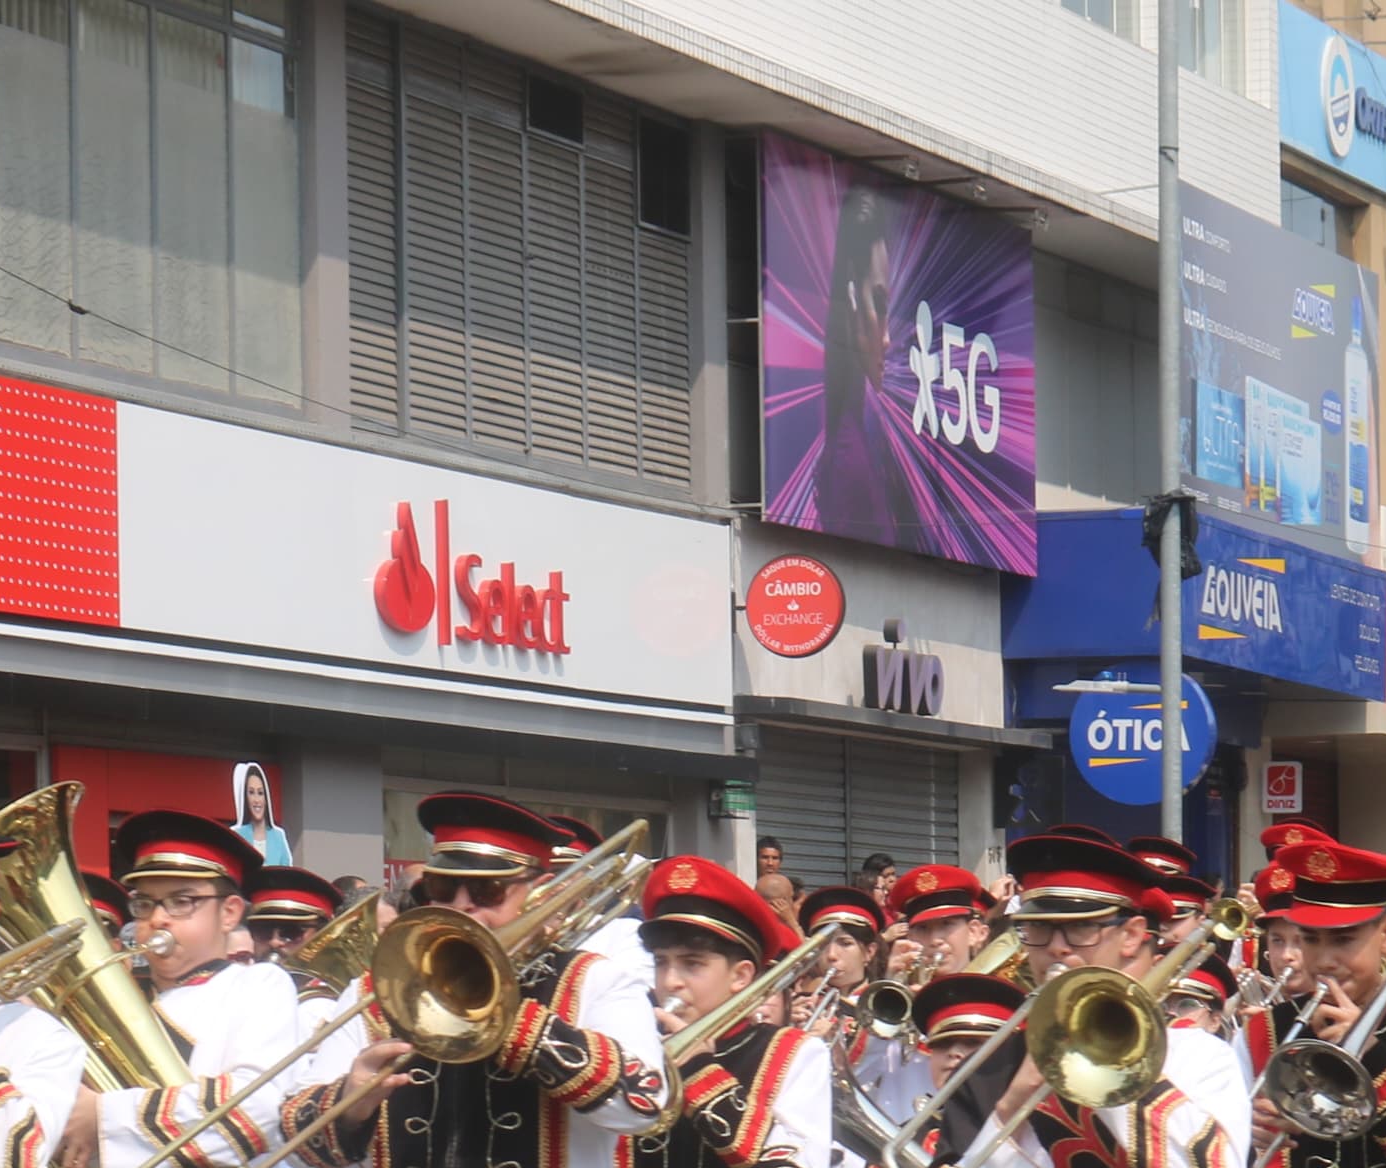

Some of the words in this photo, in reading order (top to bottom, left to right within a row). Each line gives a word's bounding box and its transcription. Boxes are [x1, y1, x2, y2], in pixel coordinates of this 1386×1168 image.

[941, 321, 1001, 453] 5G
[761, 559, 786, 580] SAQUE
[787, 558, 800, 568] EM
[764, 580, 822, 598] CÂMBIO
[454, 553, 571, 656] Select
[763, 613, 824, 627] EXCHANGE
[1201, 564, 1283, 634] GOUVEIA
